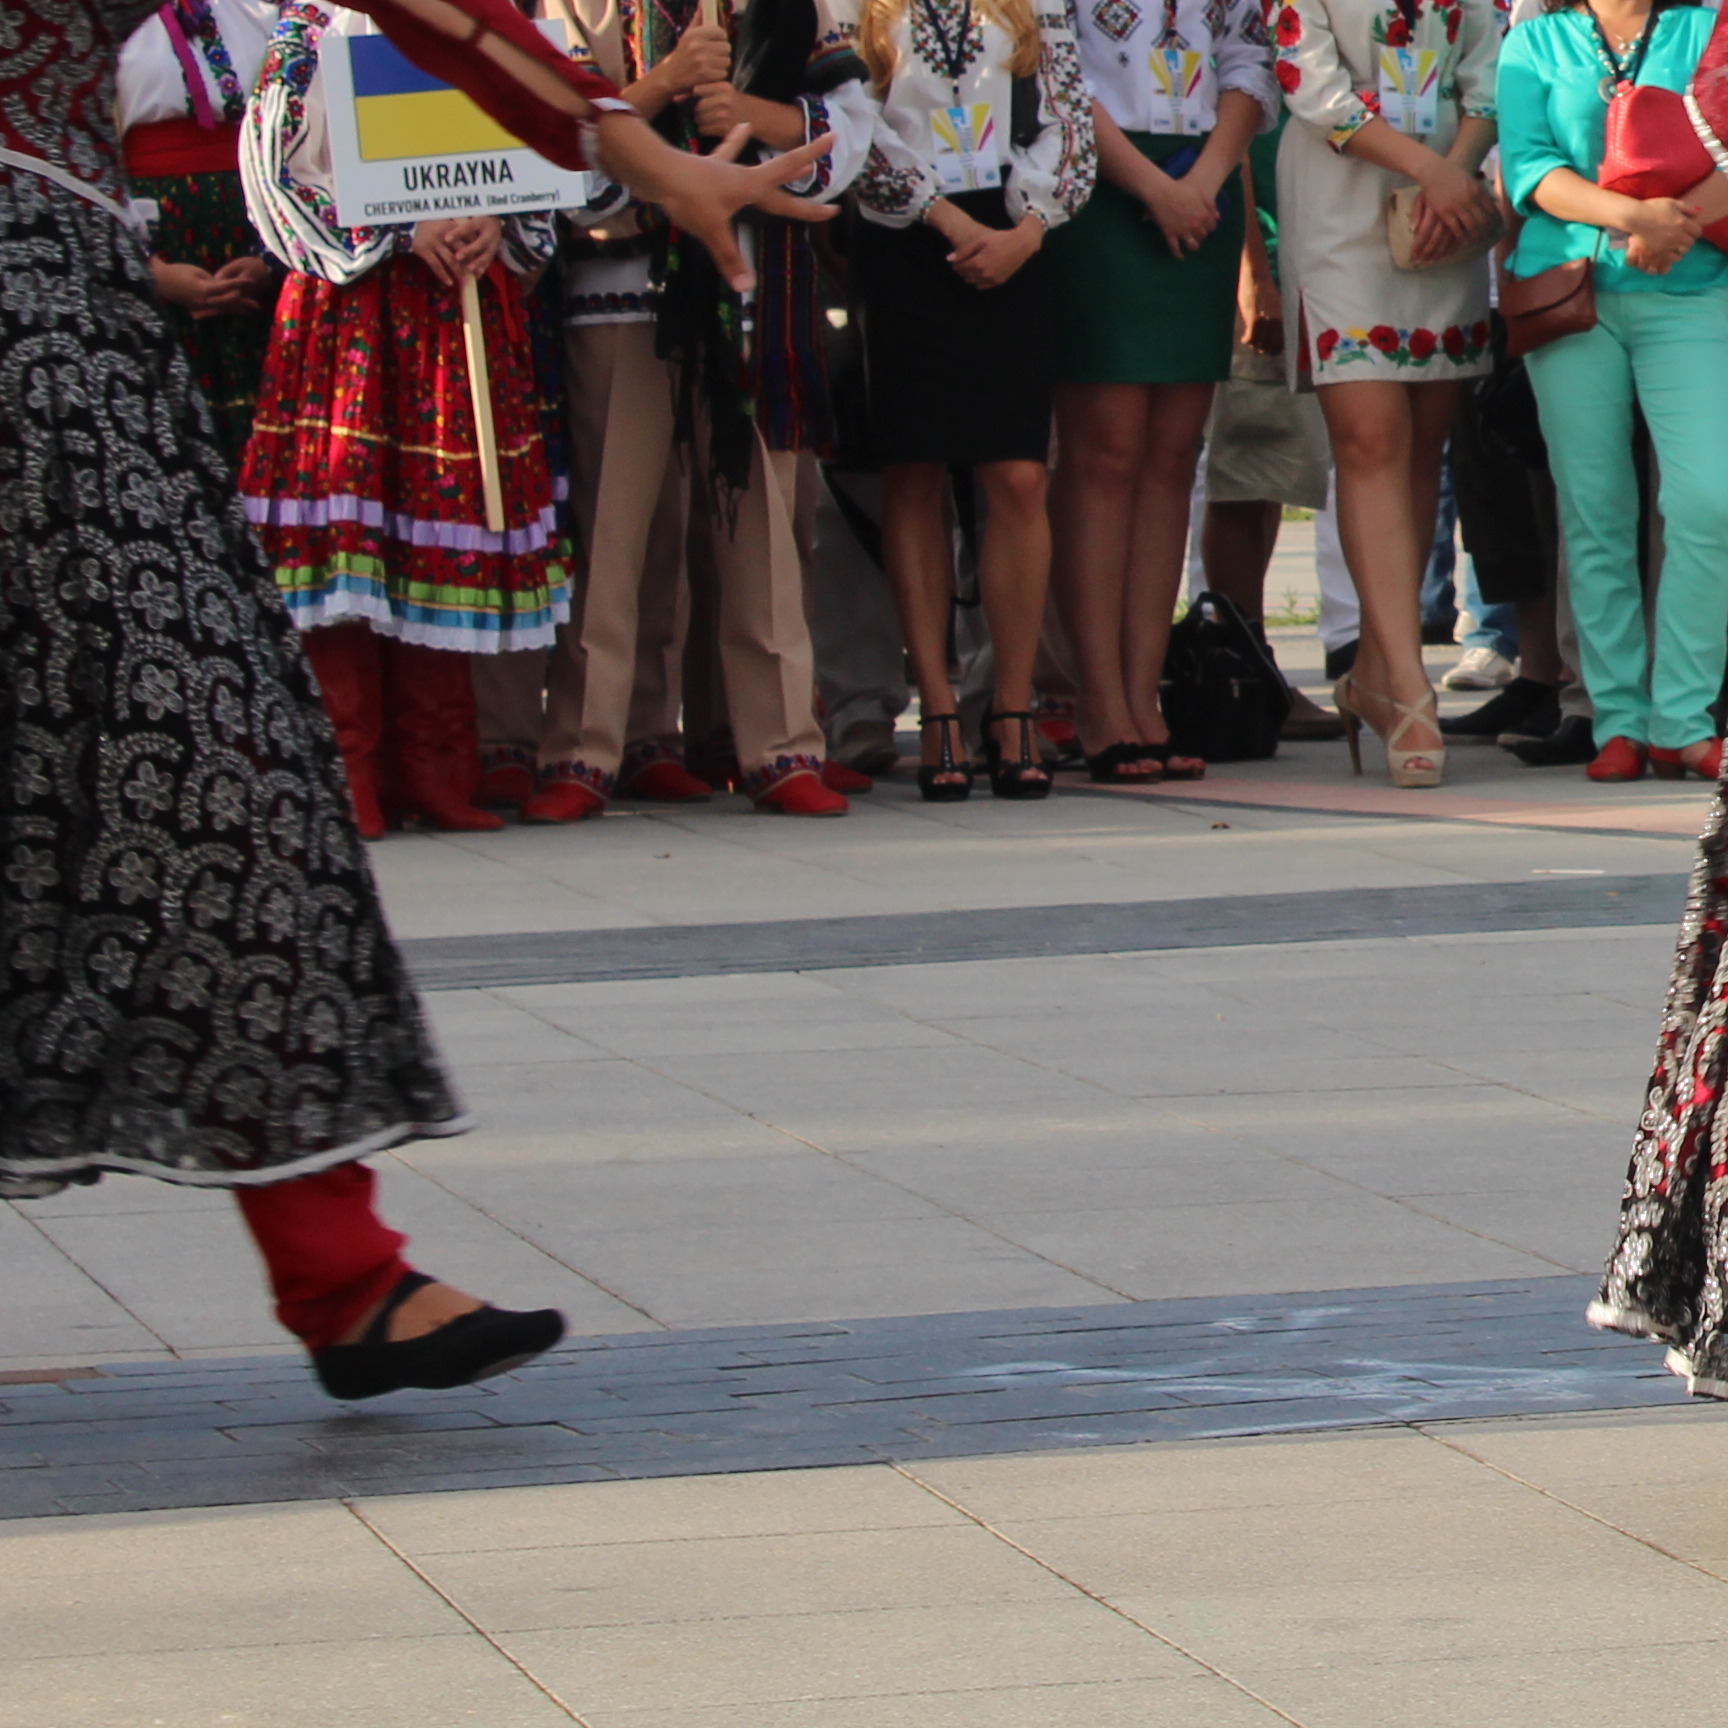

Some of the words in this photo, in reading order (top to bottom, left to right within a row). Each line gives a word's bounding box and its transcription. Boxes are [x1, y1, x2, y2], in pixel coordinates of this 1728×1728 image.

[403, 158, 515, 191] UKRAYNA
[364, 198, 430, 217] CHERVONA
[433, 195, 481, 211] KALYNA
